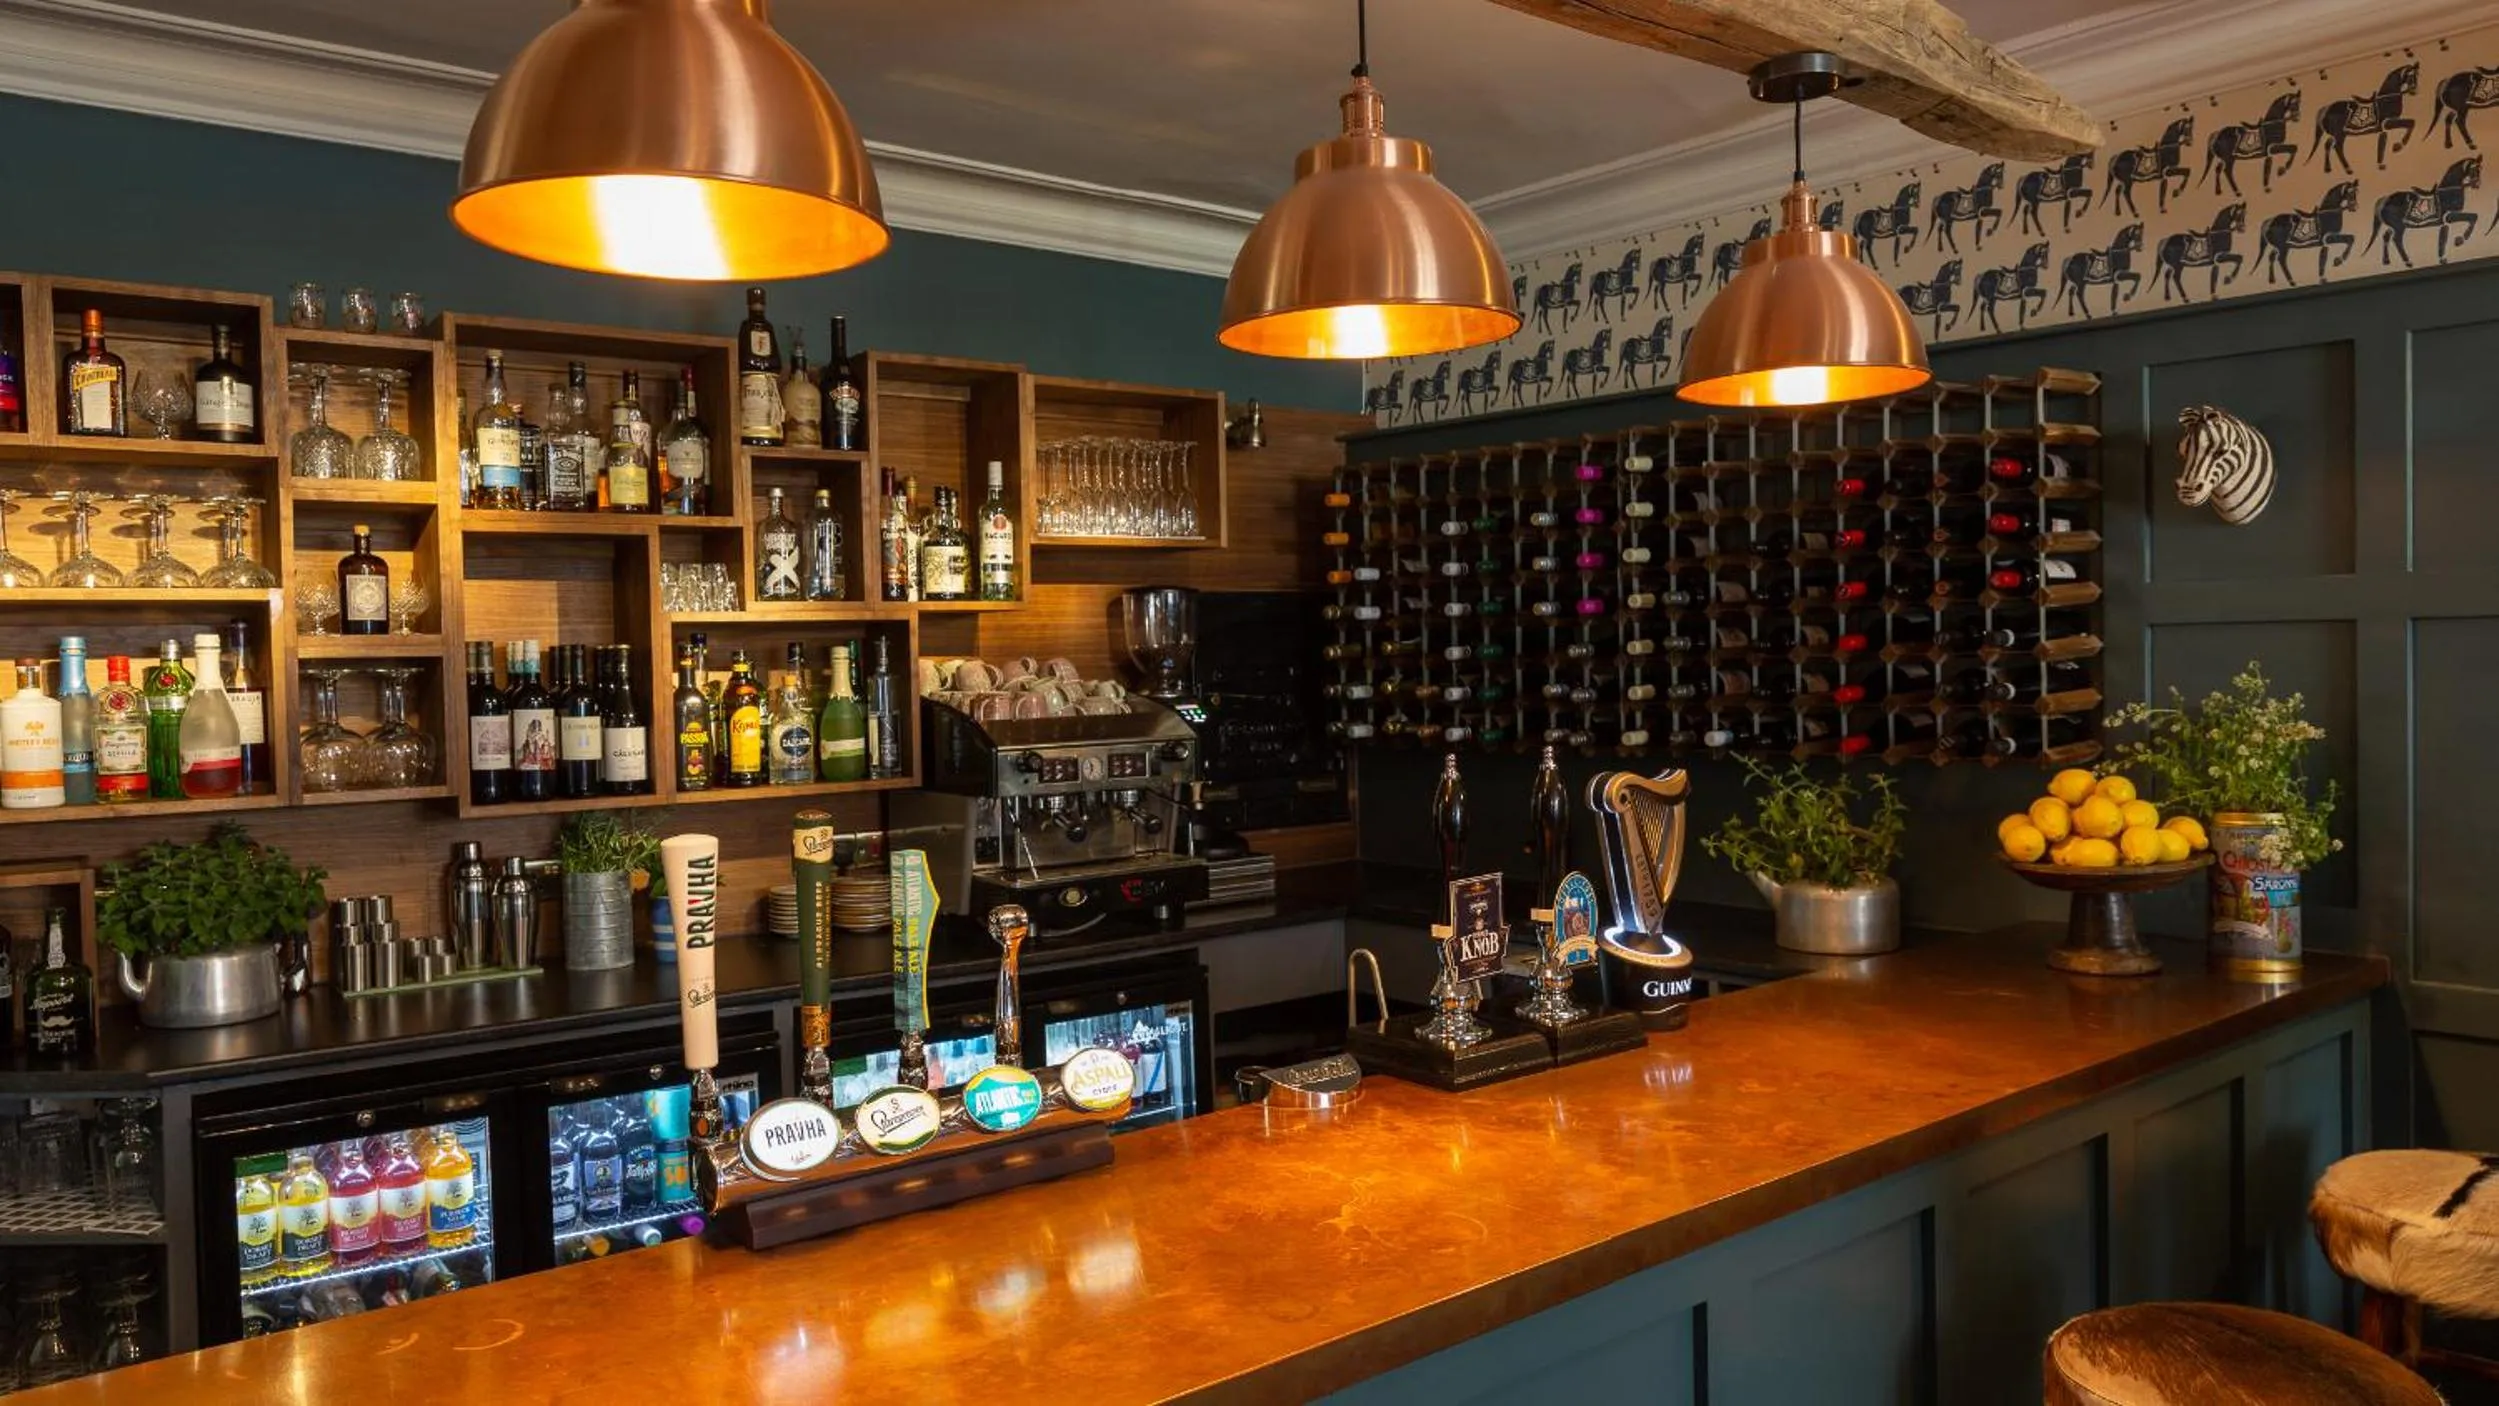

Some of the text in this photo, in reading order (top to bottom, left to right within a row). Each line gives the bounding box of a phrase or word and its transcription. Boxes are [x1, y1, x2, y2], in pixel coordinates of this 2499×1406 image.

[687, 854, 715, 949] PRAVHA
[1460, 931, 1500, 962] KNOB
[1071, 1062, 1131, 1093] ASPALL
[765, 1117, 826, 1148] PRAVHA
